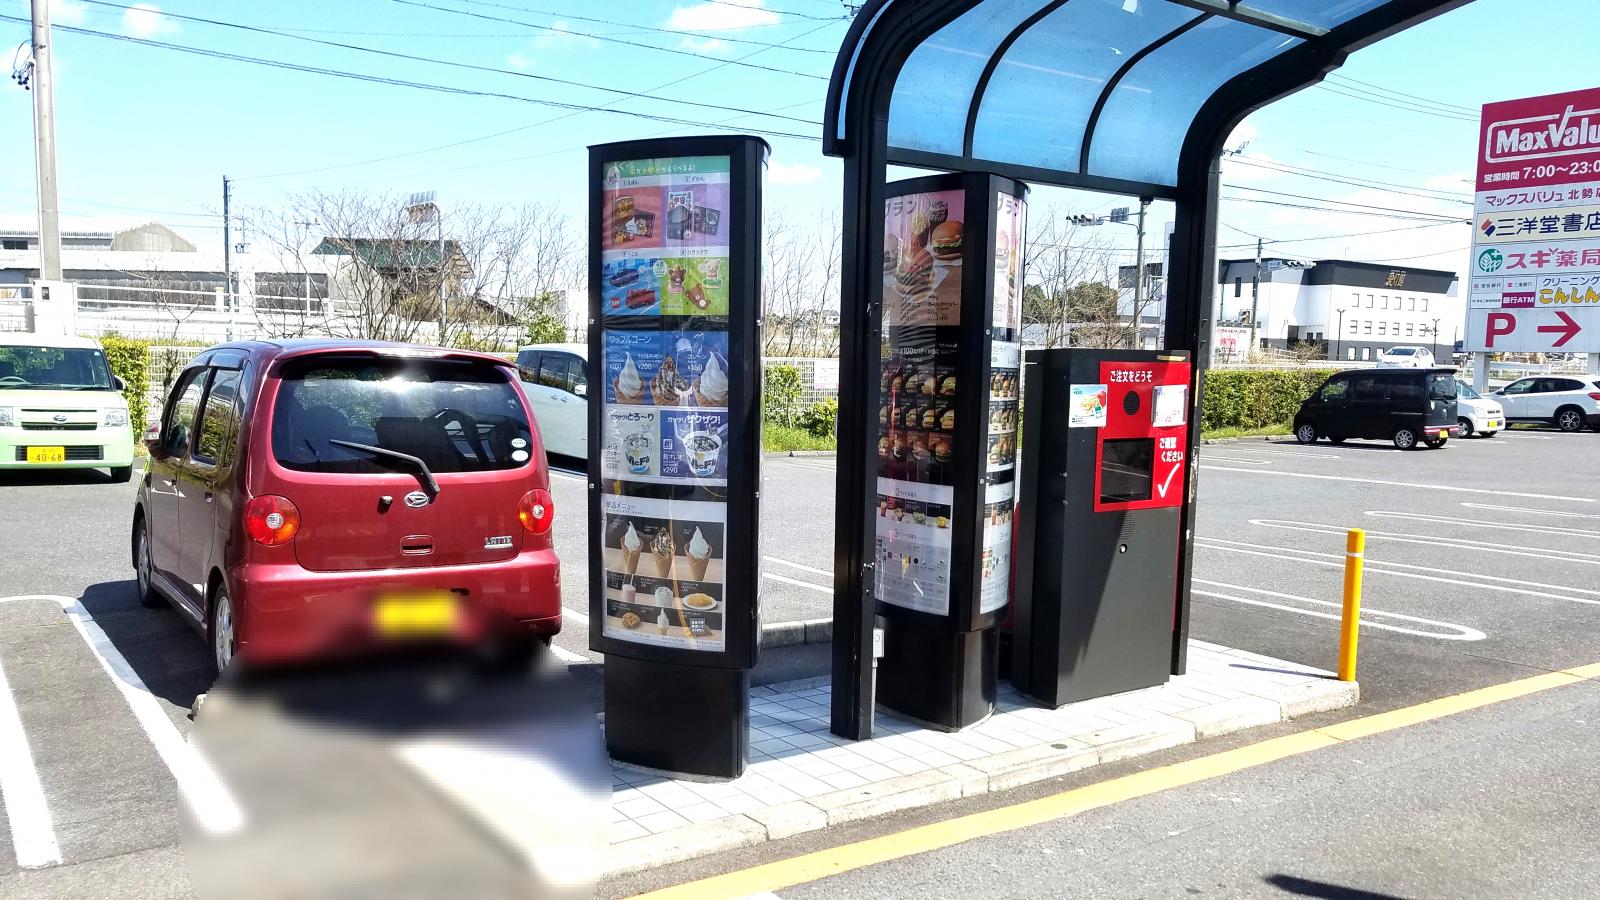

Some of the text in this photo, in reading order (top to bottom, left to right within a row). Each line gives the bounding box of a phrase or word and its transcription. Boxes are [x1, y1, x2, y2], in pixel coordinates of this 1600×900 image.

[1484, 171, 1520, 183] 営業時間
[1486, 191, 1564, 206] マックスバリュ
[1496, 211, 1600, 236] 三洋堂書店
[1506, 247, 1600, 269] スギ薬局
[1503, 296, 1534, 304] 銀行ATM
[1485, 312, 1517, 348] P
[609, 335, 652, 344] ワッフルコーン
[1110, 370, 1153, 383] ご注文をどうぞ
[1161, 451, 1184, 462] ください
